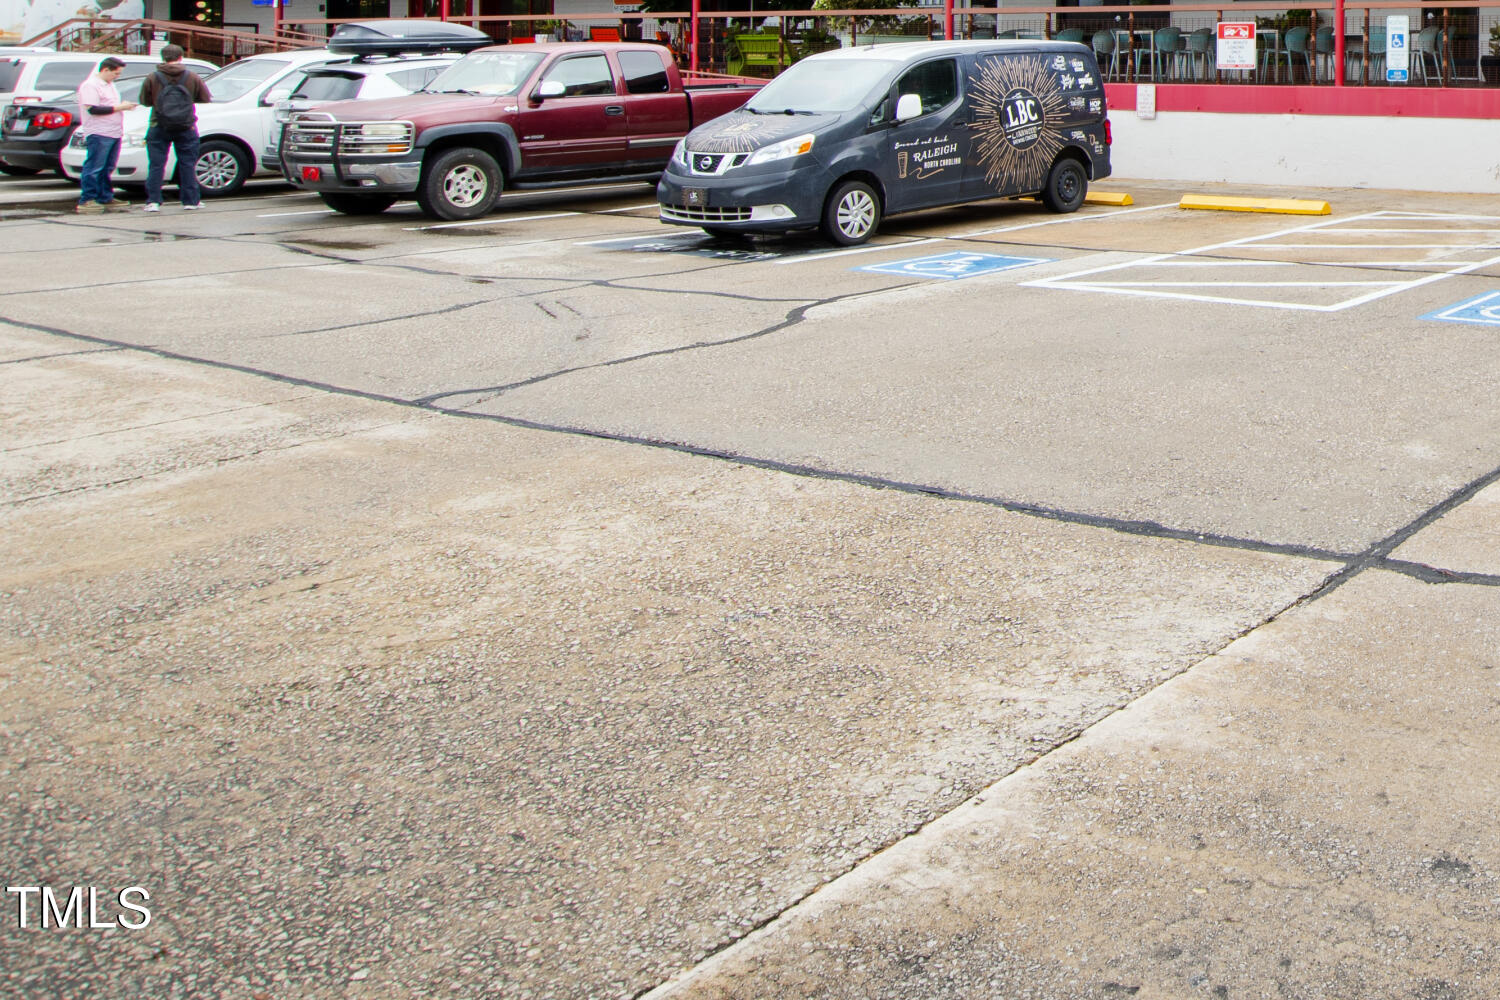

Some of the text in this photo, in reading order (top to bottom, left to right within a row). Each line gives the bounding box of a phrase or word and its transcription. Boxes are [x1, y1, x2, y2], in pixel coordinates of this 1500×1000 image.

[1007, 99, 1039, 128] LBC
[913, 142, 958, 163] RALEIGH
[924, 157, 962, 169] NORTH CAROLINA
